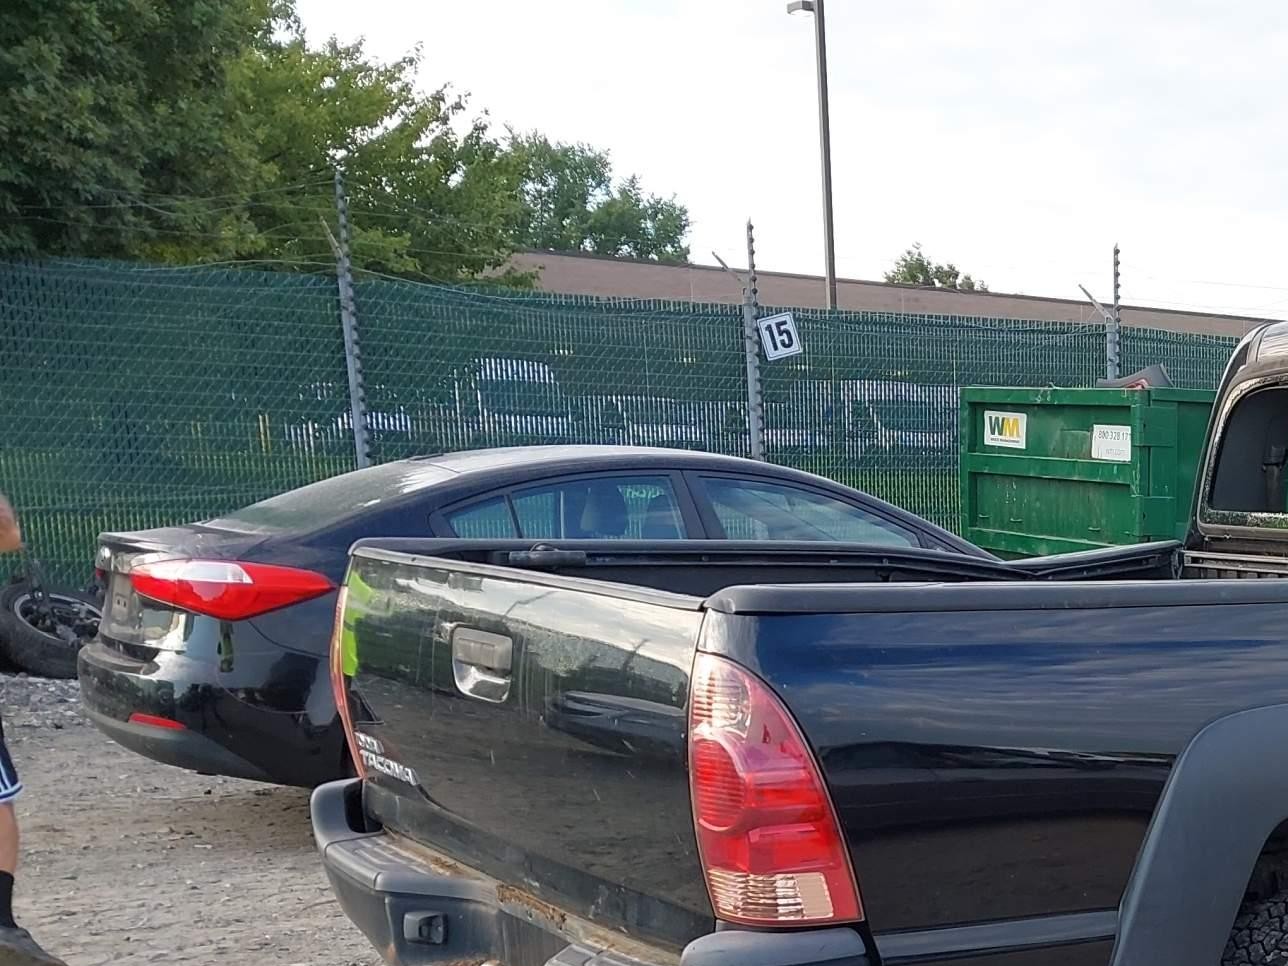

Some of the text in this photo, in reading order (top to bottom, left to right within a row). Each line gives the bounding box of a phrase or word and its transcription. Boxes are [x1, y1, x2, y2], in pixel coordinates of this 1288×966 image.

[765, 320, 793, 351] 15
[989, 416, 1020, 438] WM
[359, 749, 418, 787] TACOMA
